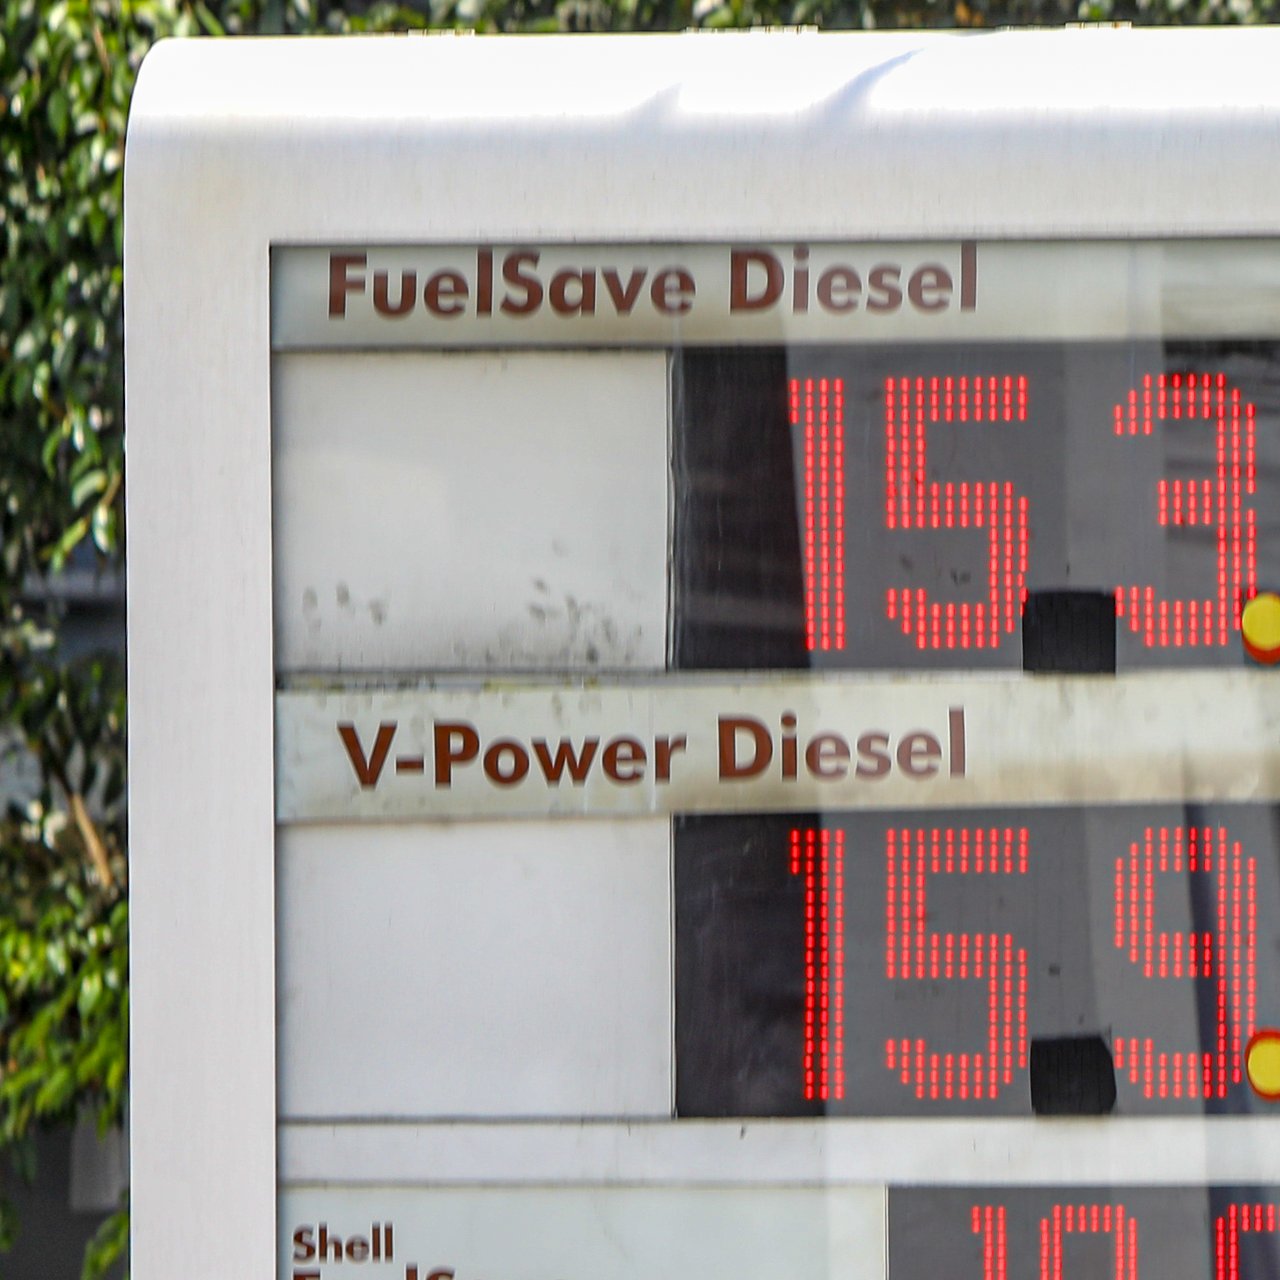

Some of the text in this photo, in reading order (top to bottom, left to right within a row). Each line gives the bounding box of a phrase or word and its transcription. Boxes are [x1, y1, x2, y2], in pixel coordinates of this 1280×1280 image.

[326, 241, 978, 320] FuelSave Diesel
[336, 707, 967, 790] V-Power Diesel
[292, 1221, 394, 1264] Shell
